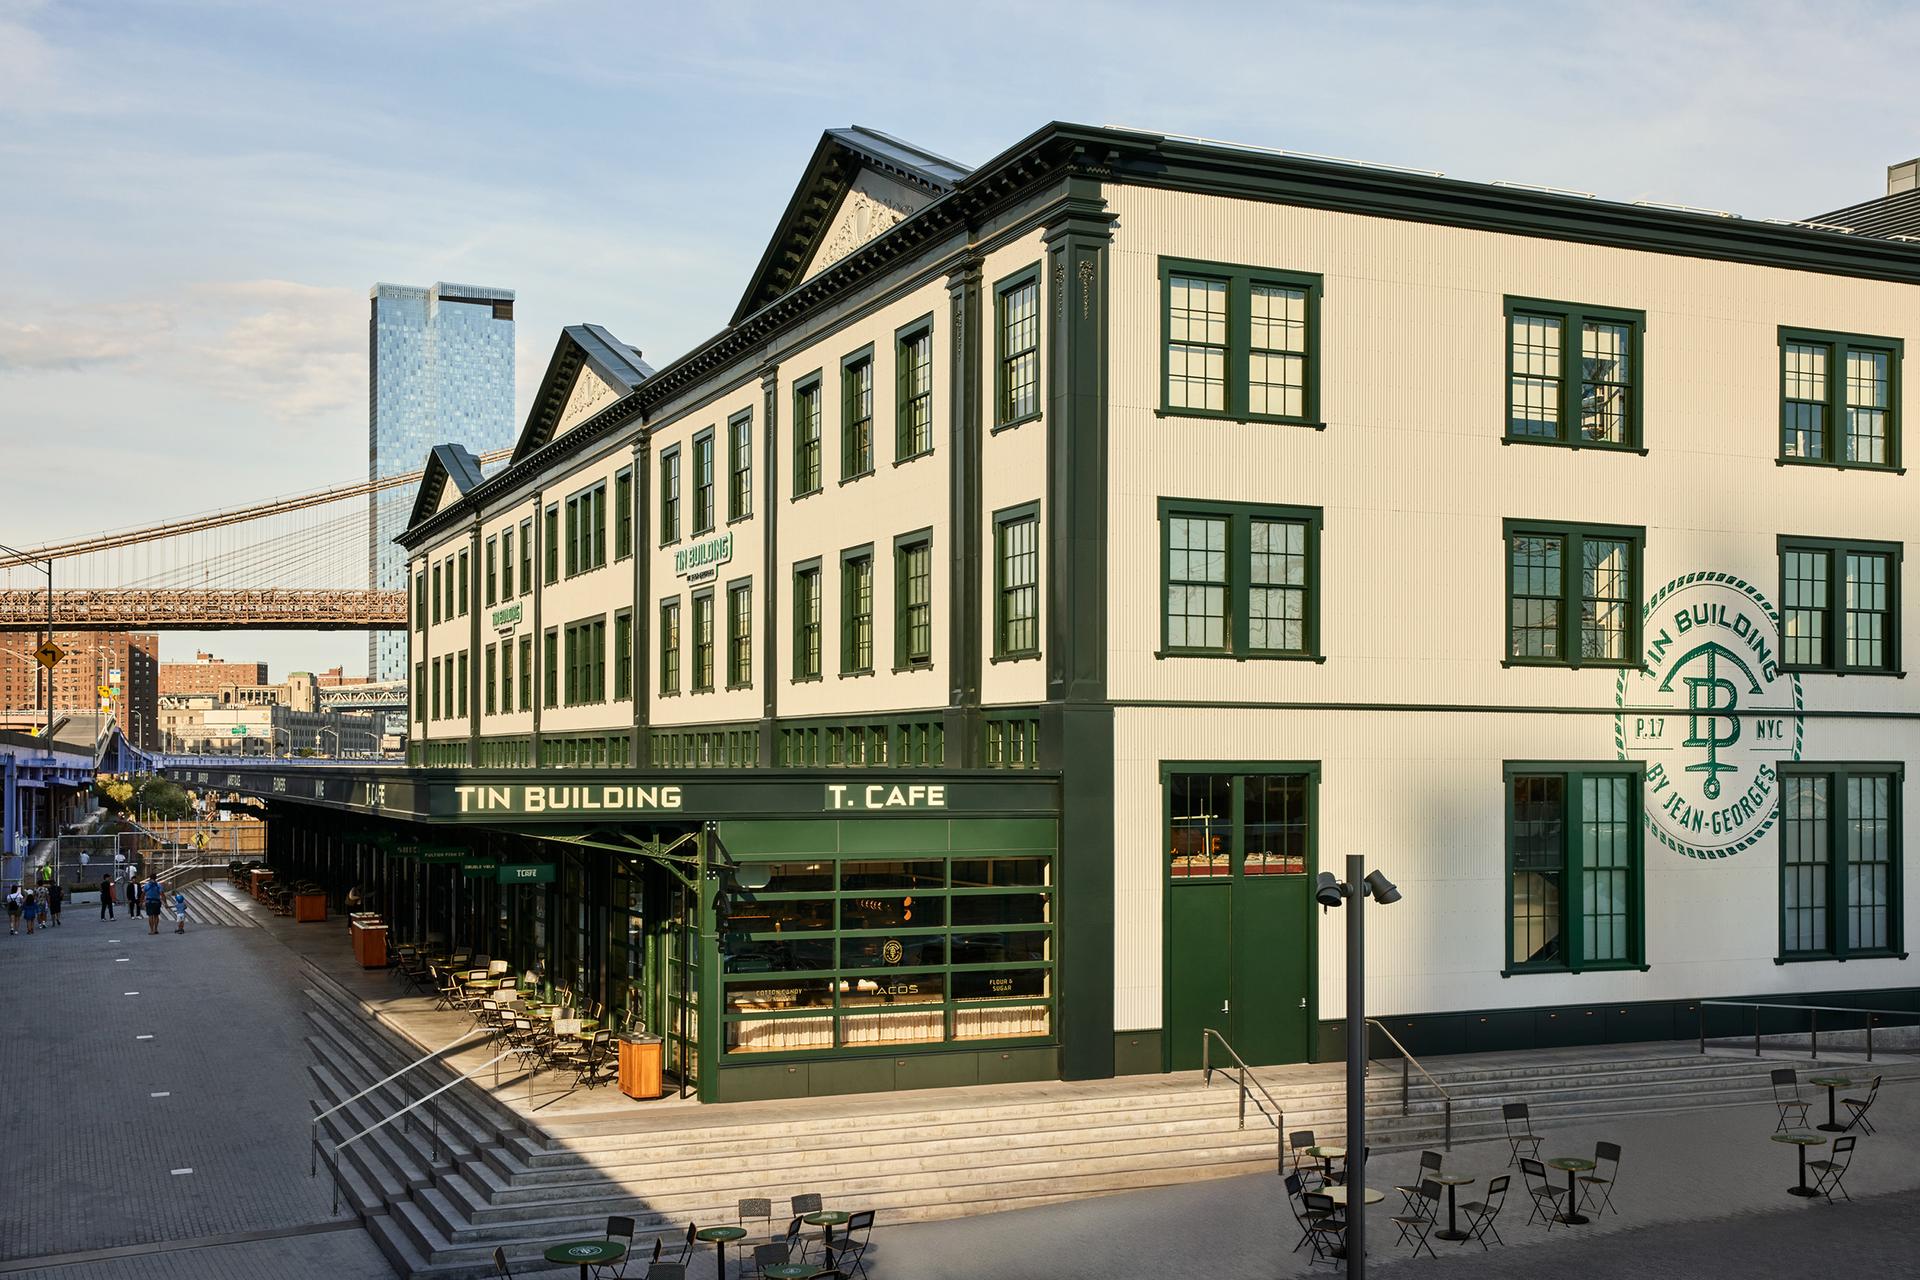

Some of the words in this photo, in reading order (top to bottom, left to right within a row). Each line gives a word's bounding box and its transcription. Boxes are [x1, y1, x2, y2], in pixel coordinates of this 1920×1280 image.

[675, 549, 688, 573] TIN
[689, 535, 729, 568] BUILDING
[1641, 628, 1674, 681] TIN
[1674, 602, 1780, 685] BUILDING
[1636, 718, 1666, 739] P.17
[1757, 719, 1784, 740] NYC
[455, 787, 511, 812] TIN
[525, 787, 682, 812] BUILDING
[828, 785, 854, 809] T.
[865, 785, 945, 809] CAFE
[1646, 762, 1671, 795] BY
[1663, 763, 1777, 836] JEAN-GEORGES
[755, 989, 779, 997] COTTON
[992, 984, 1012, 992] SUGAR
